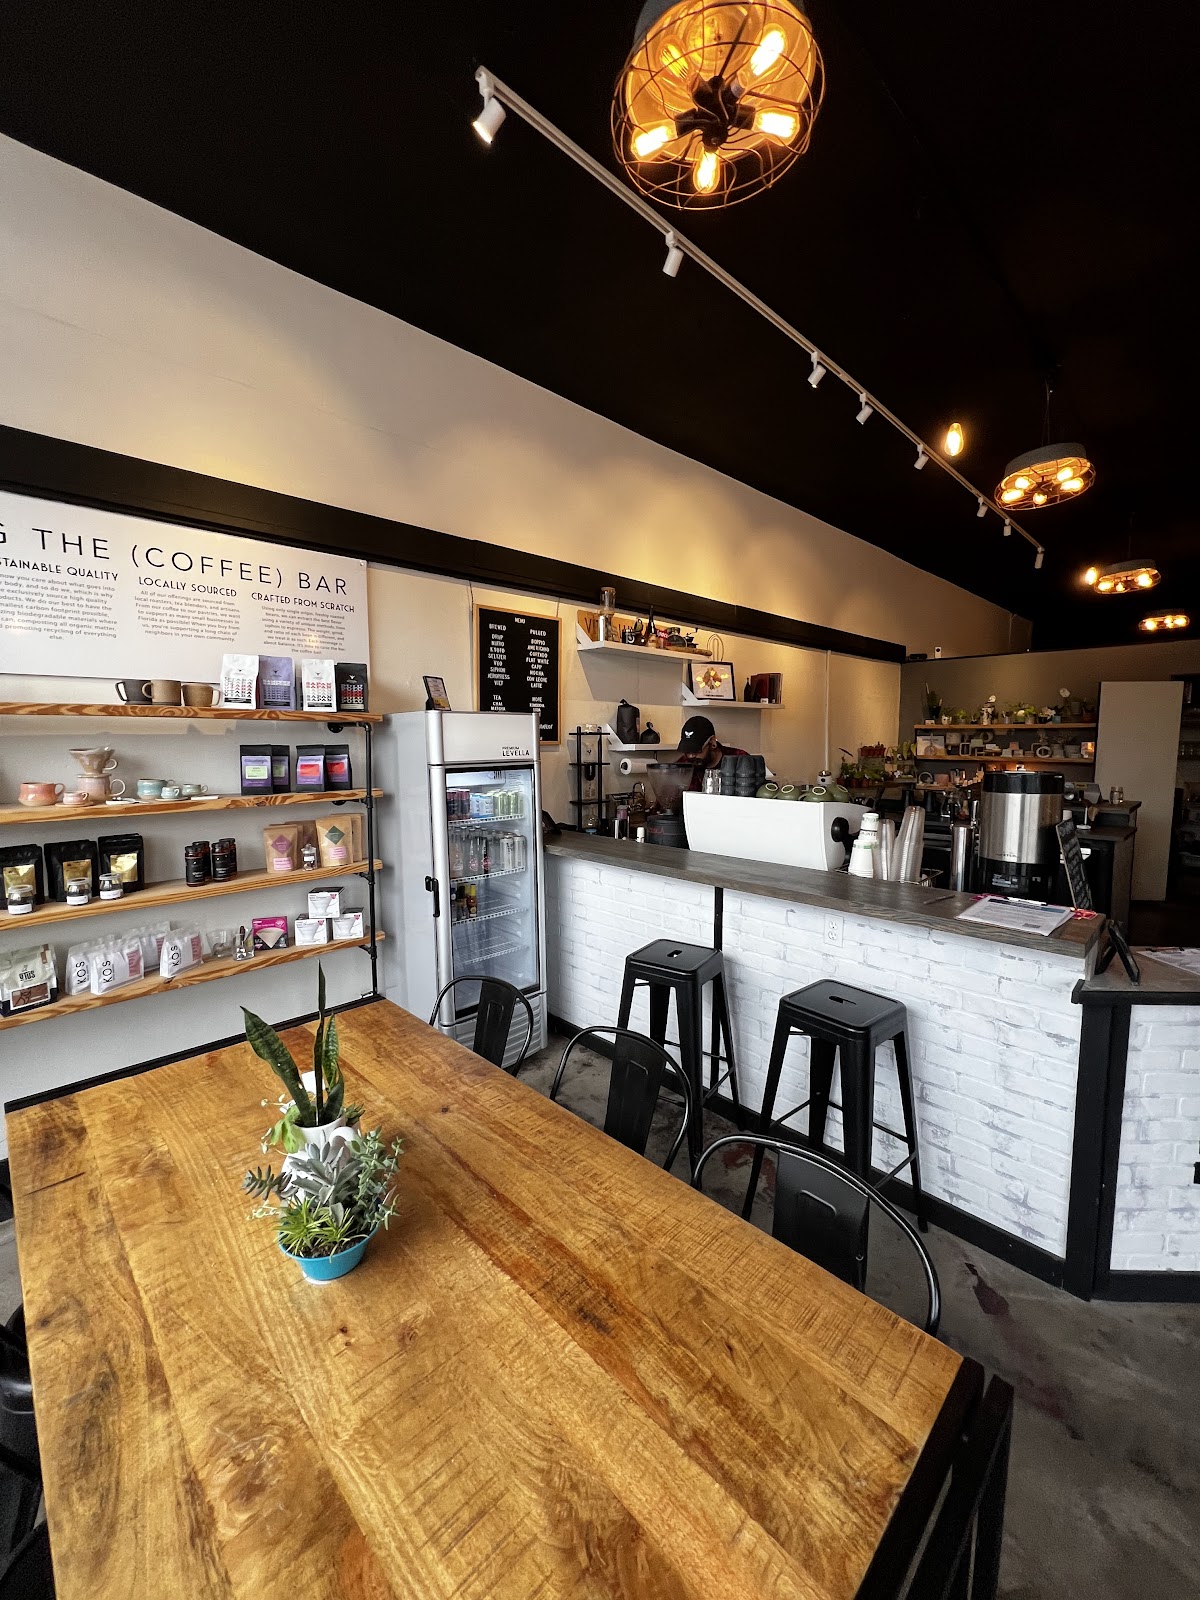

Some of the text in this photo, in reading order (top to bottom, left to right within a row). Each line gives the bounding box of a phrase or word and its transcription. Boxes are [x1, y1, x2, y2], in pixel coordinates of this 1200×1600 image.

[0, 558, 118, 581] TAINABLE QUALITY
[32, 528, 110, 560] THE
[131, 544, 282, 588] (COFFEE)
[298, 572, 347, 596] BAR
[7, 589, 44, 598] exclusively
[138, 576, 237, 597] LOCALLY SOURCED
[251, 592, 355, 613] CRAFTED FROM SCRATCH
[170, 945, 180, 967] KOS
[76, 961, 86, 984] KOS
[102, 960, 113, 984] KOS
